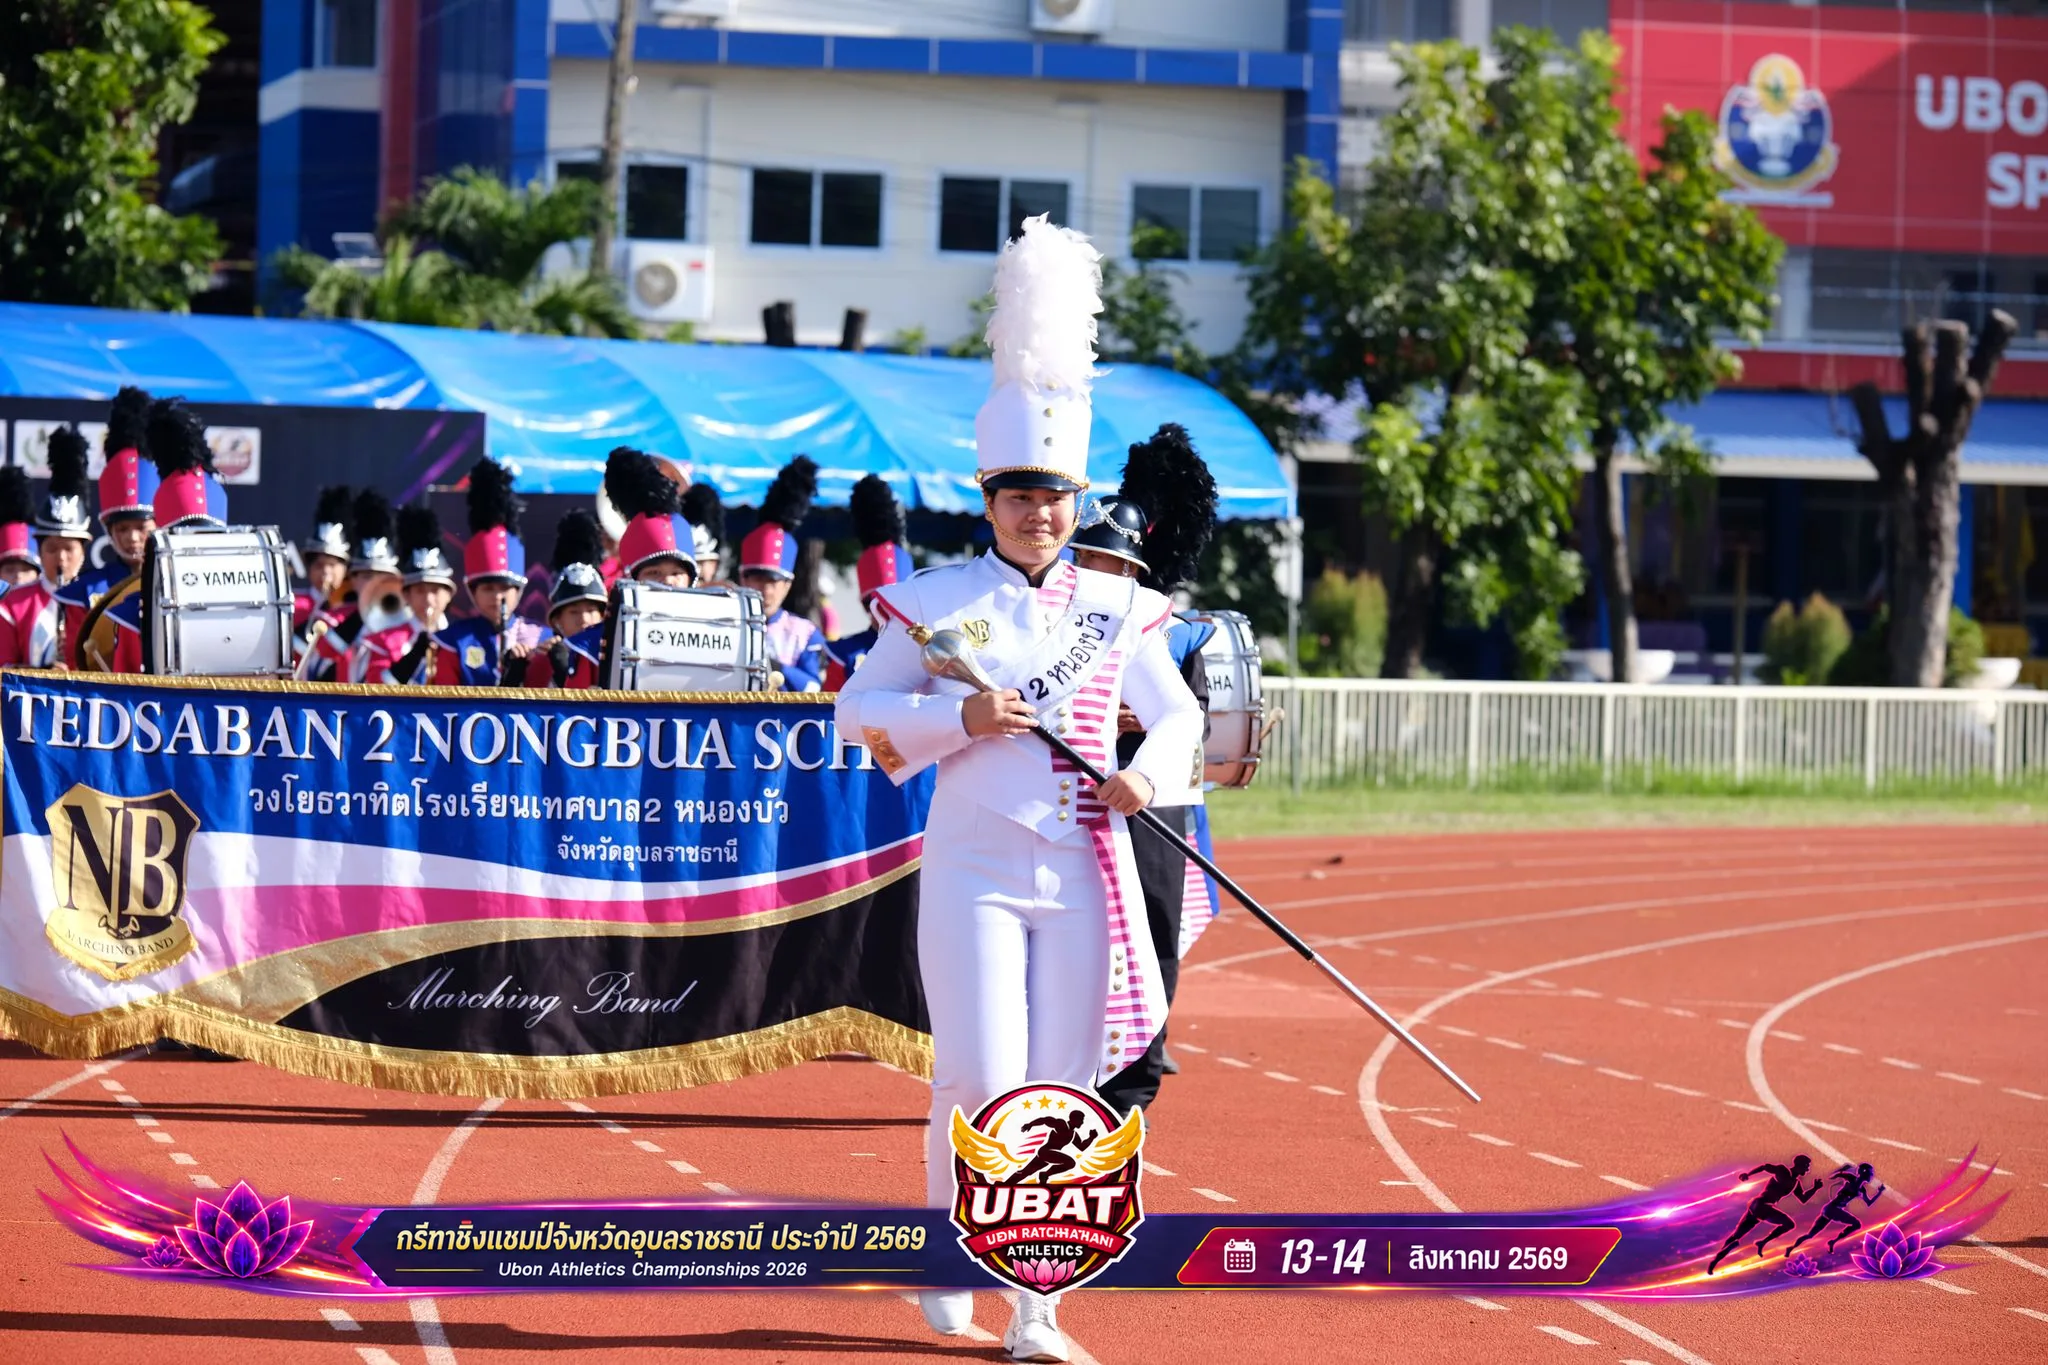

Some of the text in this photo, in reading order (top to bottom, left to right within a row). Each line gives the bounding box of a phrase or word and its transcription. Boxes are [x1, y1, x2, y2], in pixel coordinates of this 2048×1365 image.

[1915, 74, 2048, 136] UBO
[203, 570, 268, 586] YAMAHA
[669, 631, 732, 651] YAMAHA
[1029, 612, 1109, 700] 2 หนองบัว
[8, 690, 348, 762] TEDSABAN
[363, 709, 394, 762] 2
[409, 711, 738, 770] NONGBUA
[248, 773, 790, 824] วงโยธวาทิตโรงเรียนเทศบาล2 หนองบัว
[63, 805, 178, 924] NB
[557, 834, 738, 872] จังหวัดอุบลราชธานี
[66, 929, 175, 956] MARCHING BAND
[387, 967, 698, 1029] Marching Band
